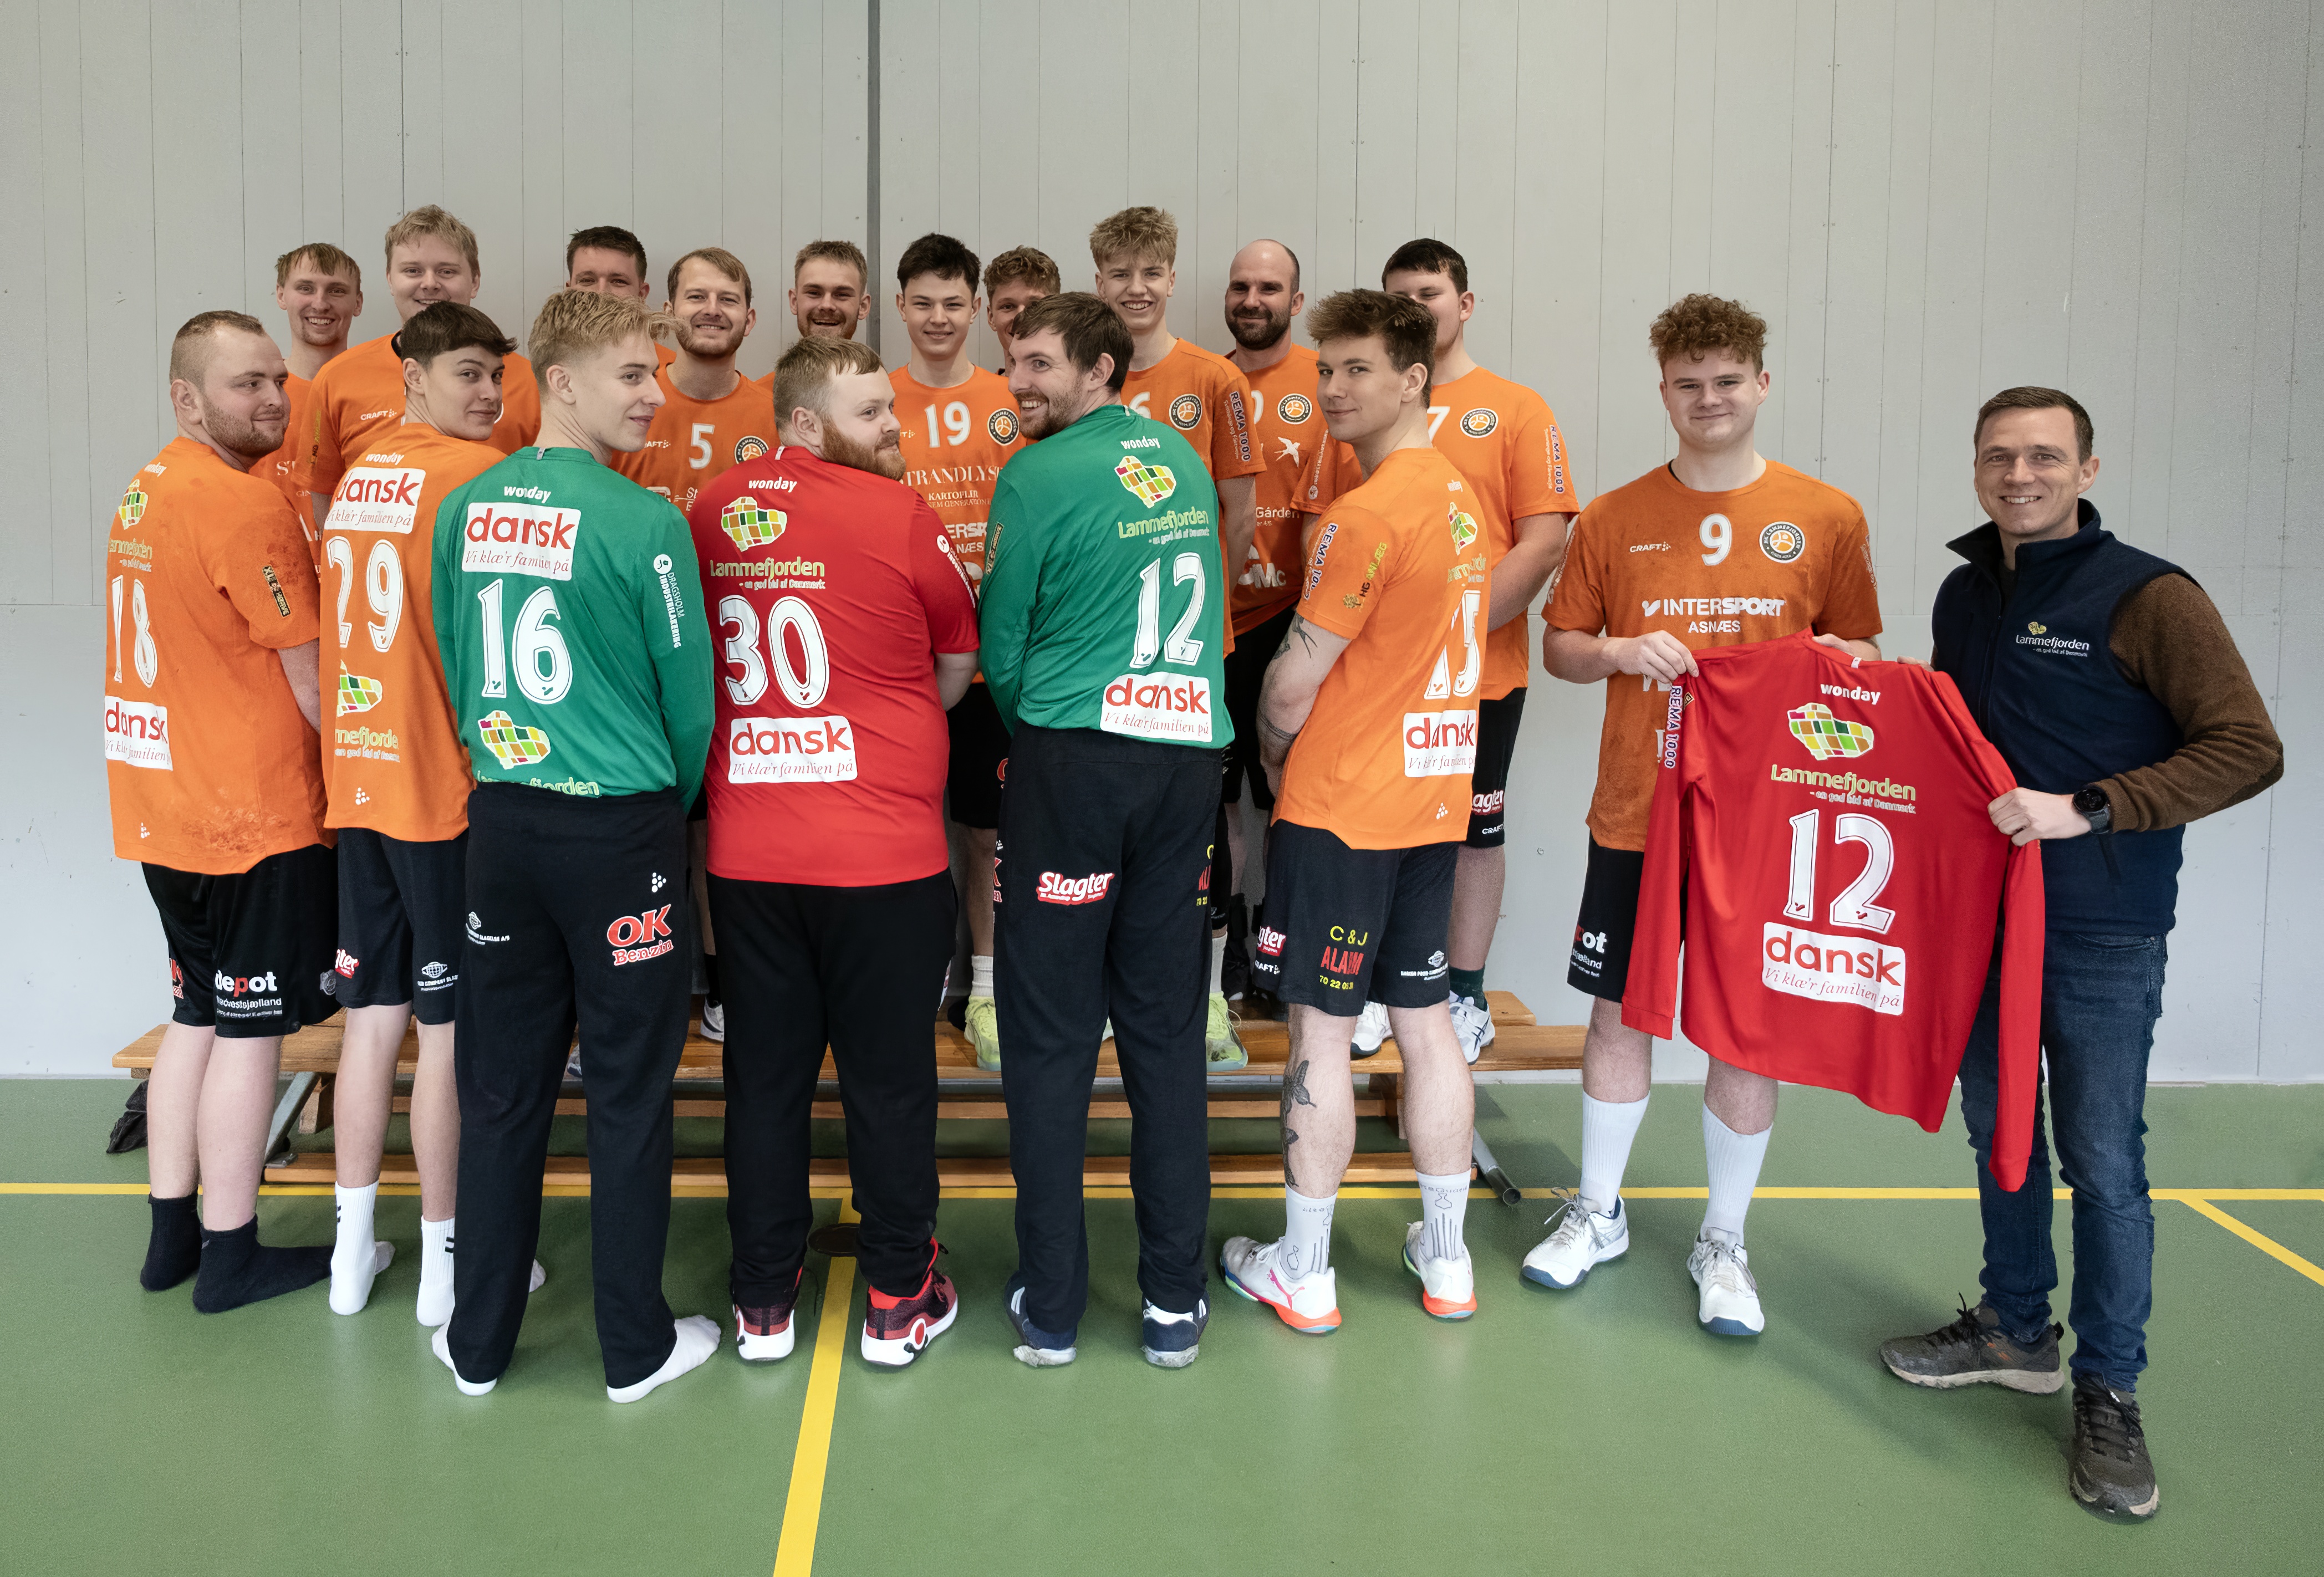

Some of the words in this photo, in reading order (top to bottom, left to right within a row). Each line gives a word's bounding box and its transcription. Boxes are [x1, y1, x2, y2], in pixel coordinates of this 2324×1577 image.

[361, 411, 389, 420] CRAFT
[924, 401, 971, 448] 19
[1230, 391, 1246, 431] REMA
[1239, 431, 1251, 461] 1000
[1427, 406, 1450, 442] 7
[365, 452, 405, 465] wonday
[689, 422, 715, 469] 5
[1120, 436, 1160, 450] wonday
[336, 471, 420, 506] dansk
[504, 486, 551, 503] wonday
[748, 476, 797, 492] wonday
[467, 508, 575, 550] dansk
[1118, 506, 1209, 539] Lammefjorden
[1699, 513, 1732, 565] 9
[956, 542, 984, 554] NÆS
[1315, 523, 1338, 566] REMA
[1629, 543, 1662, 553] CRAFT
[466, 551, 477, 563] Vi
[553, 559, 569, 574] på
[710, 557, 824, 580] Lammefjorden
[327, 536, 404, 653] 29
[667, 572, 685, 618] DRAGSHOLM
[1359, 582, 1370, 597] HG
[1664, 597, 1785, 616] INTERSPORT
[1130, 552, 1205, 668] 12
[1688, 620, 1740, 633] ASNÆS
[112, 575, 158, 688] 18
[477, 579, 573, 705] 16
[2016, 635, 2089, 651] Lammefjorden
[719, 595, 830, 709] 30
[1106, 678, 1208, 715] dansk
[1666, 686, 1684, 731] REMA
[1820, 682, 1881, 705] wonday
[105, 702, 168, 744] dansk
[732, 721, 852, 756] dansk
[1105, 712, 1120, 724] Vi
[1198, 722, 1209, 736] på
[1406, 714, 1475, 749] dansk
[733, 763, 745, 775] Vi
[778, 762, 832, 778] familien
[837, 759, 853, 776] på
[1409, 757, 1422, 769] Vi
[1664, 733, 1679, 769] 1000
[1771, 764, 1916, 802] Lammefjorden
[1038, 871, 1113, 901] Slagter
[1783, 809, 1895, 935] 12
[607, 904, 672, 947] OK
[1330, 926, 1344, 941] C
[1347, 930, 1356, 944] &
[1358, 932, 1368, 946] J
[613, 940, 674, 966] Benzin
[1766, 931, 1902, 987] dansk
[215, 969, 278, 998] depot
[1319, 975, 1328, 985] 70
[1330, 979, 1341, 989] 22
[1765, 968, 1780, 982] Vi
[1816, 981, 1880, 1002] familien
[1879, 994, 1900, 1008] på
